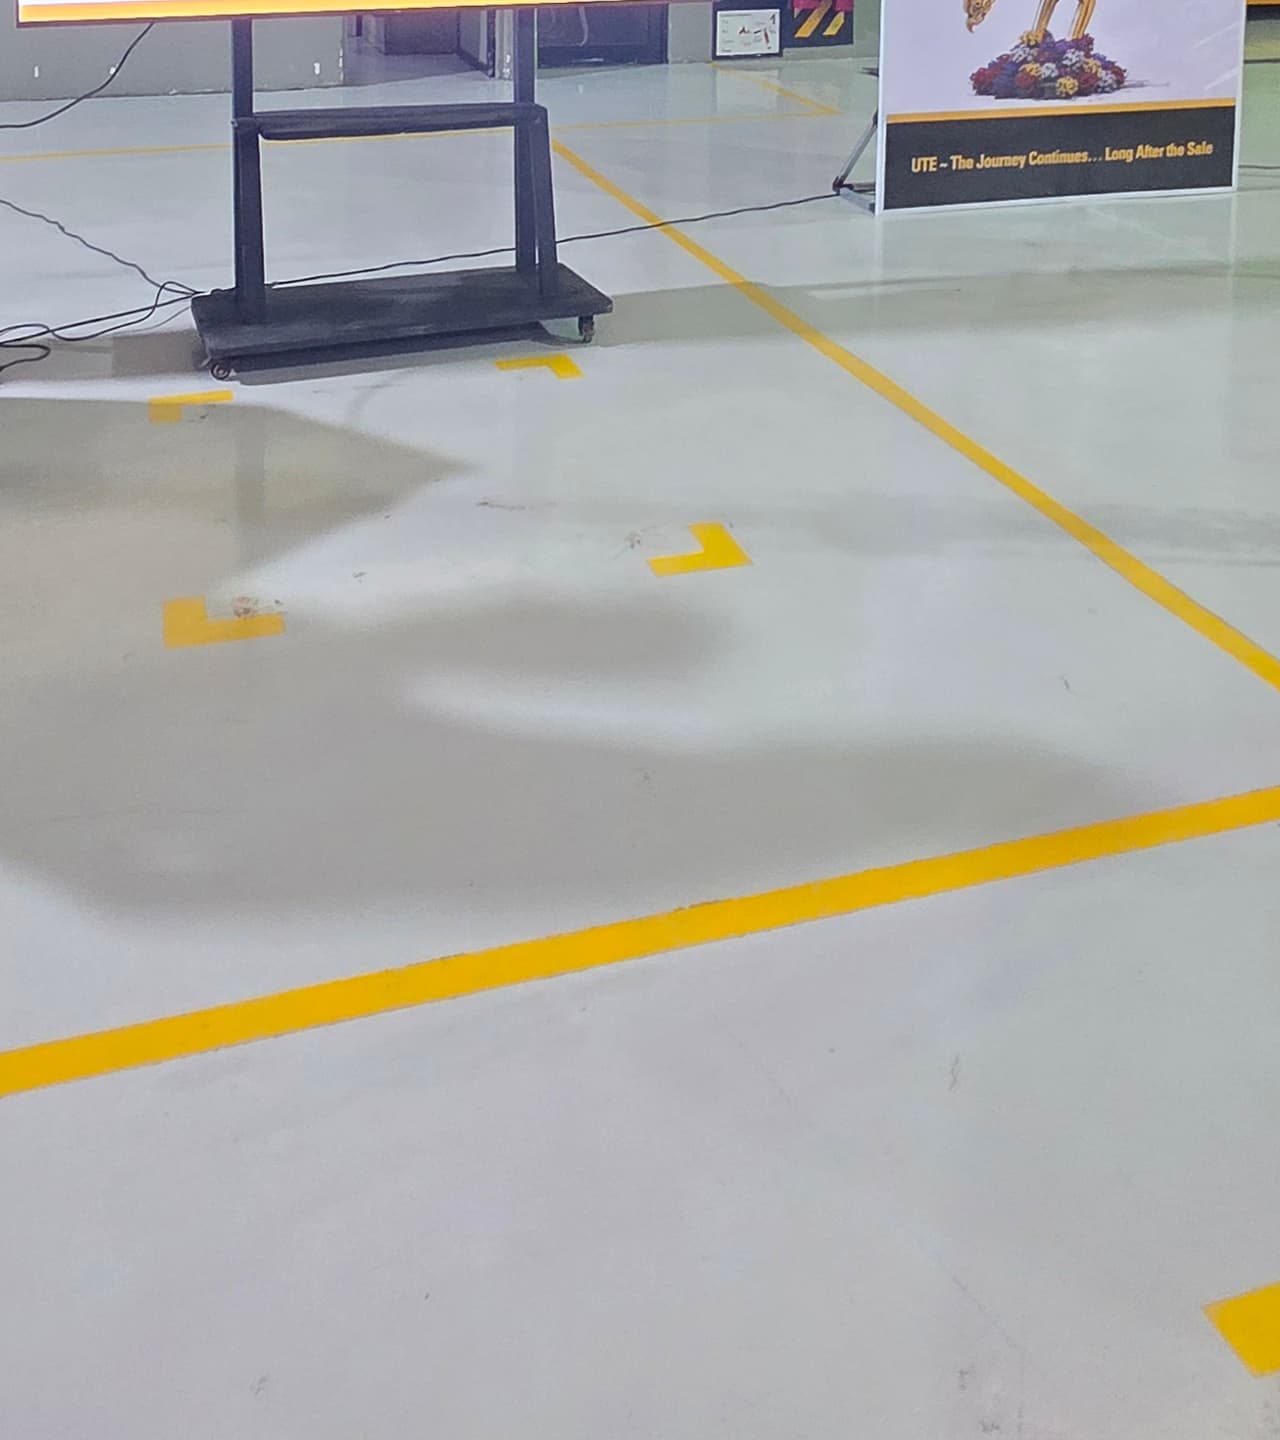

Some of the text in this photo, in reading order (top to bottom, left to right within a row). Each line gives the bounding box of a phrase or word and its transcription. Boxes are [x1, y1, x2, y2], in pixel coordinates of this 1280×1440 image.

[911, 156, 938, 173] UTE
[950, 155, 974, 172] The
[976, 152, 1026, 170] Journey
[1105, 146, 1133, 163] Long
[1136, 143, 1163, 160] After
[1166, 142, 1184, 158] the
[1187, 141, 1213, 157] Sale
